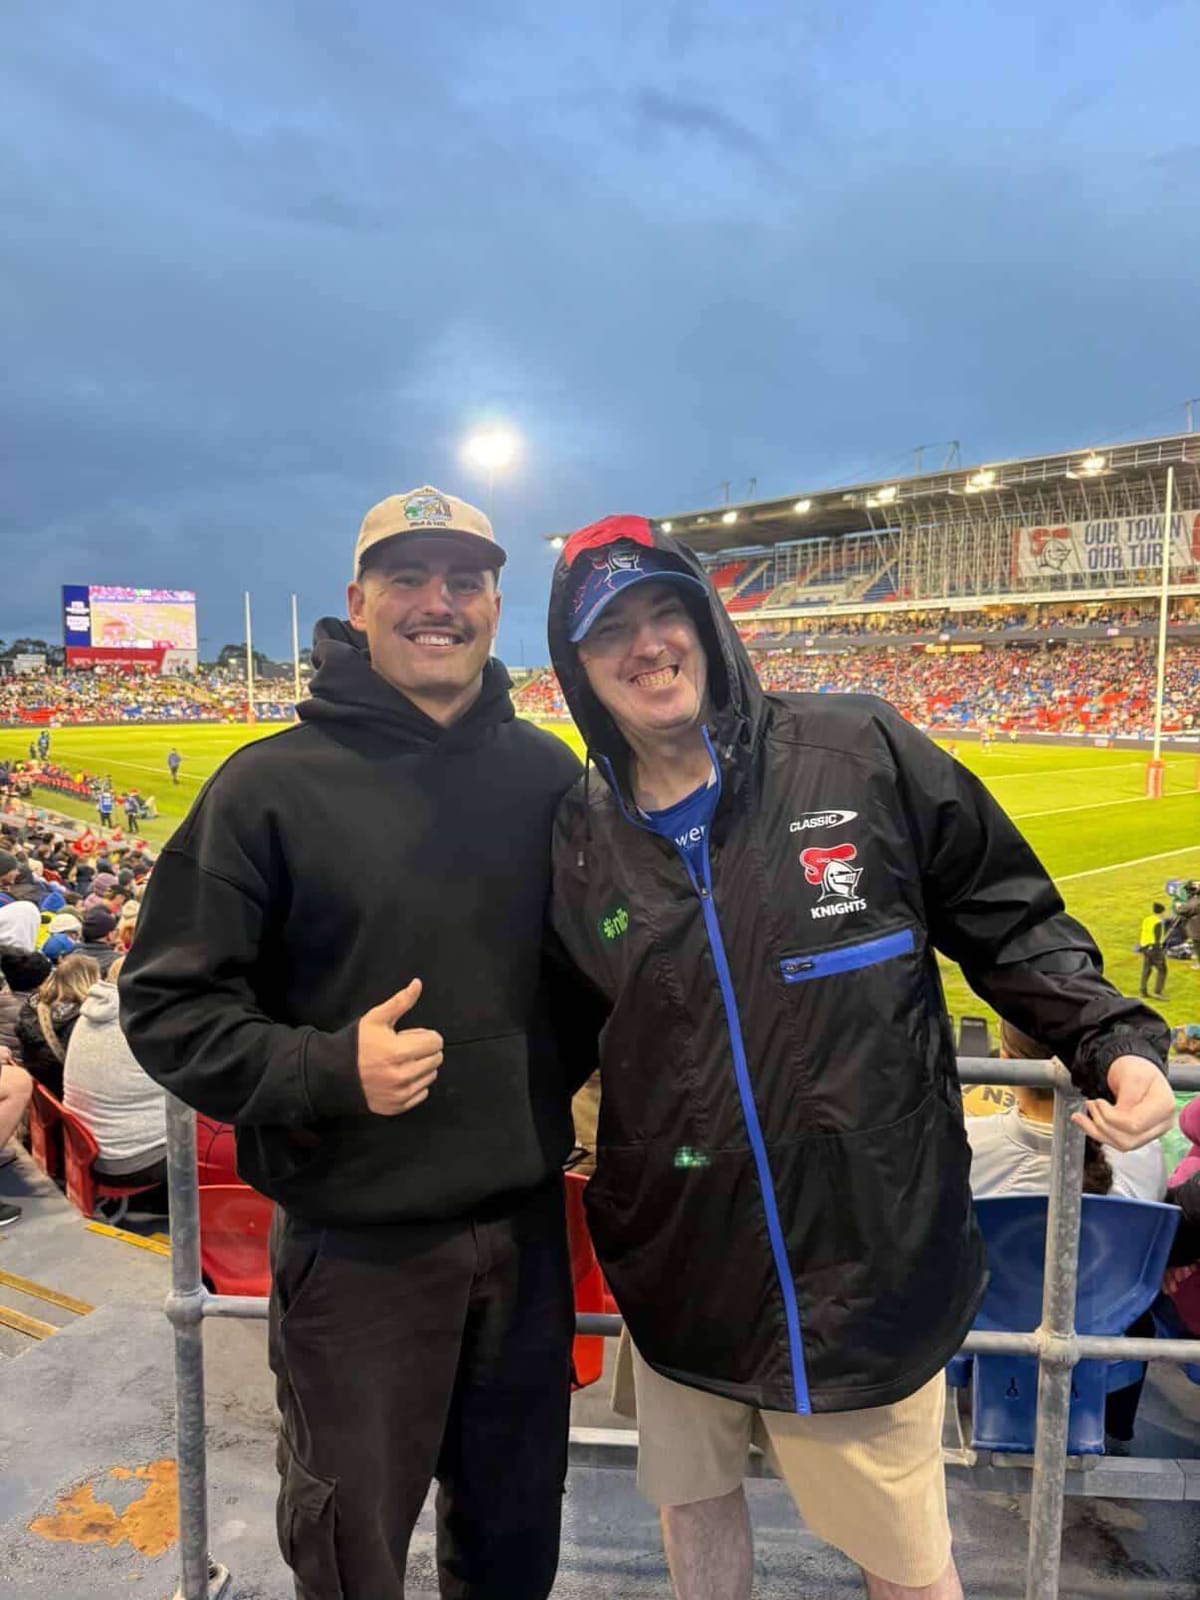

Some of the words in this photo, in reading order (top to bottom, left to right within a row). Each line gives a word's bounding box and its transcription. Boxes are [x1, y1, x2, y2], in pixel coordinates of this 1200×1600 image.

[1084, 520, 1119, 546] OUR
[1125, 514, 1182, 543] TOWN
[1088, 546, 1122, 570] OUR
[789, 813, 838, 833] CLASSIC
[810, 897, 868, 920] KNIGHTS
